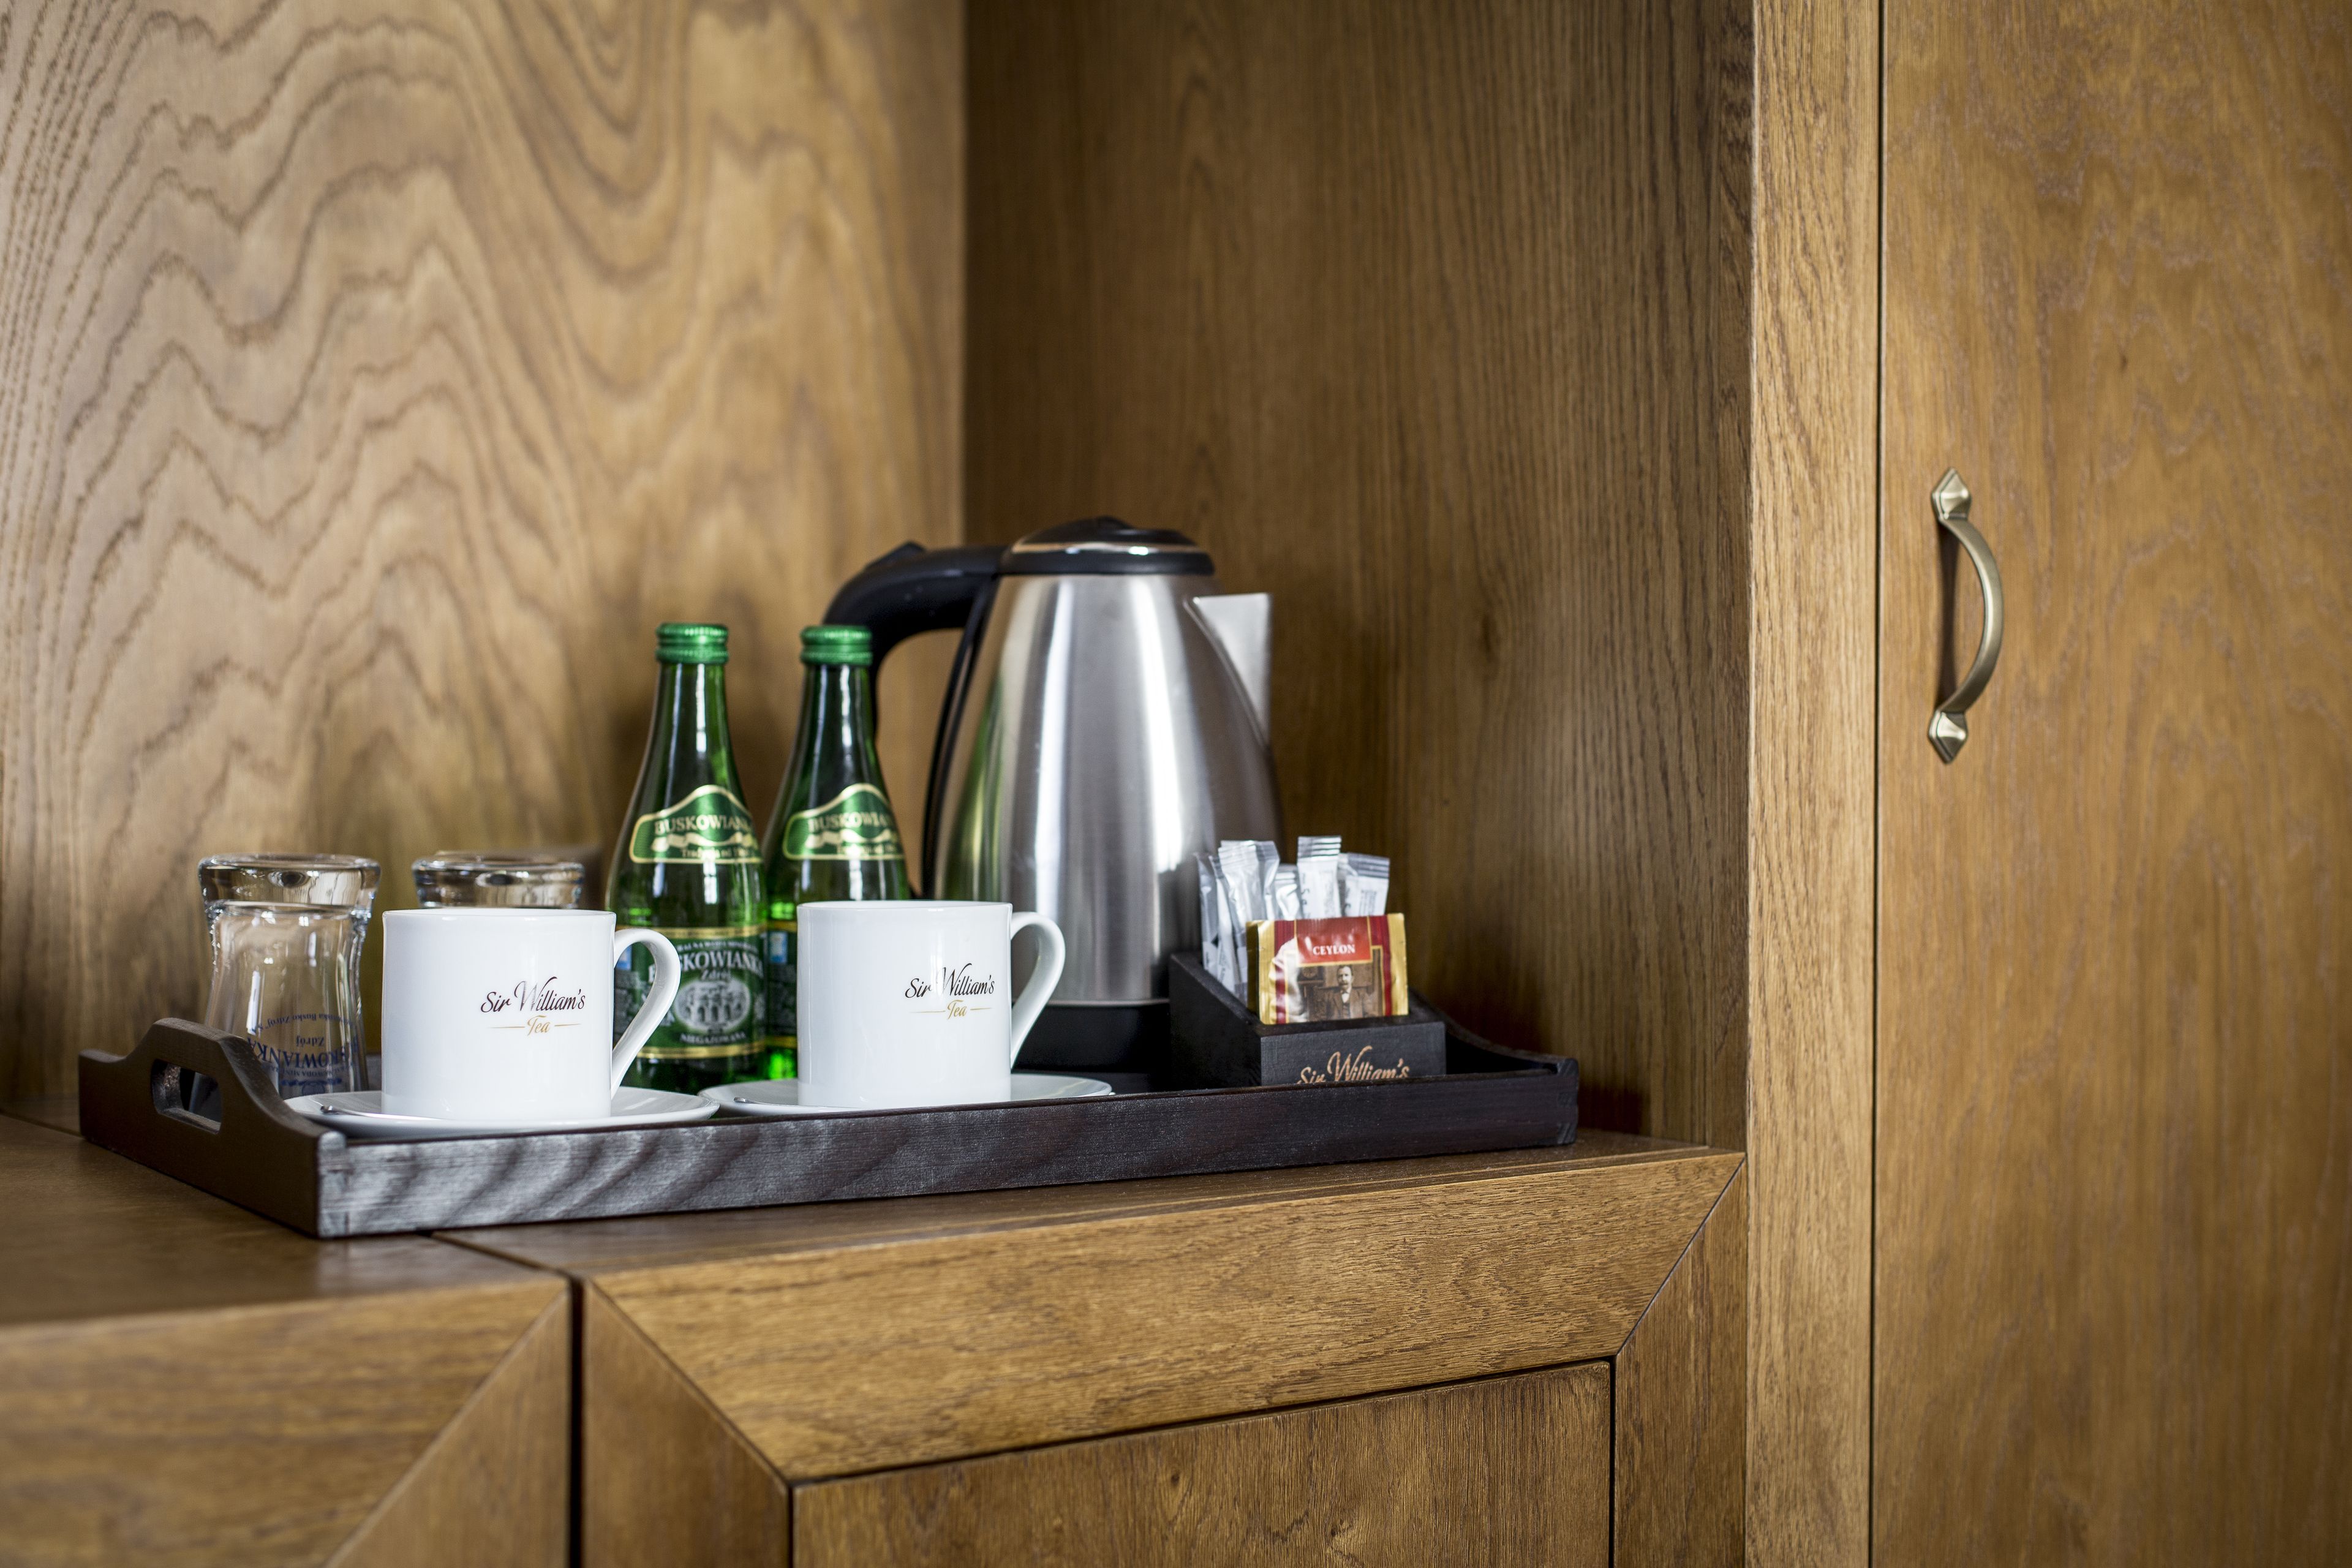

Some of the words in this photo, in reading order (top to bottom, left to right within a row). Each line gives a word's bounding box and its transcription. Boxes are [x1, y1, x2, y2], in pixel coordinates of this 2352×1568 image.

[1313, 944, 1356, 956] CEYLON
[905, 978, 932, 998] Sir
[936, 963, 995, 996] William's
[481, 992, 512, 1012] Sir
[514, 976, 586, 1011] William's
[947, 999, 968, 1020] Tea
[527, 1015, 551, 1036] Tea
[296, 1035, 325, 1047] Zdrój
[1297, 1066, 1327, 1084] Sir
[1327, 1046, 1409, 1082] William's
